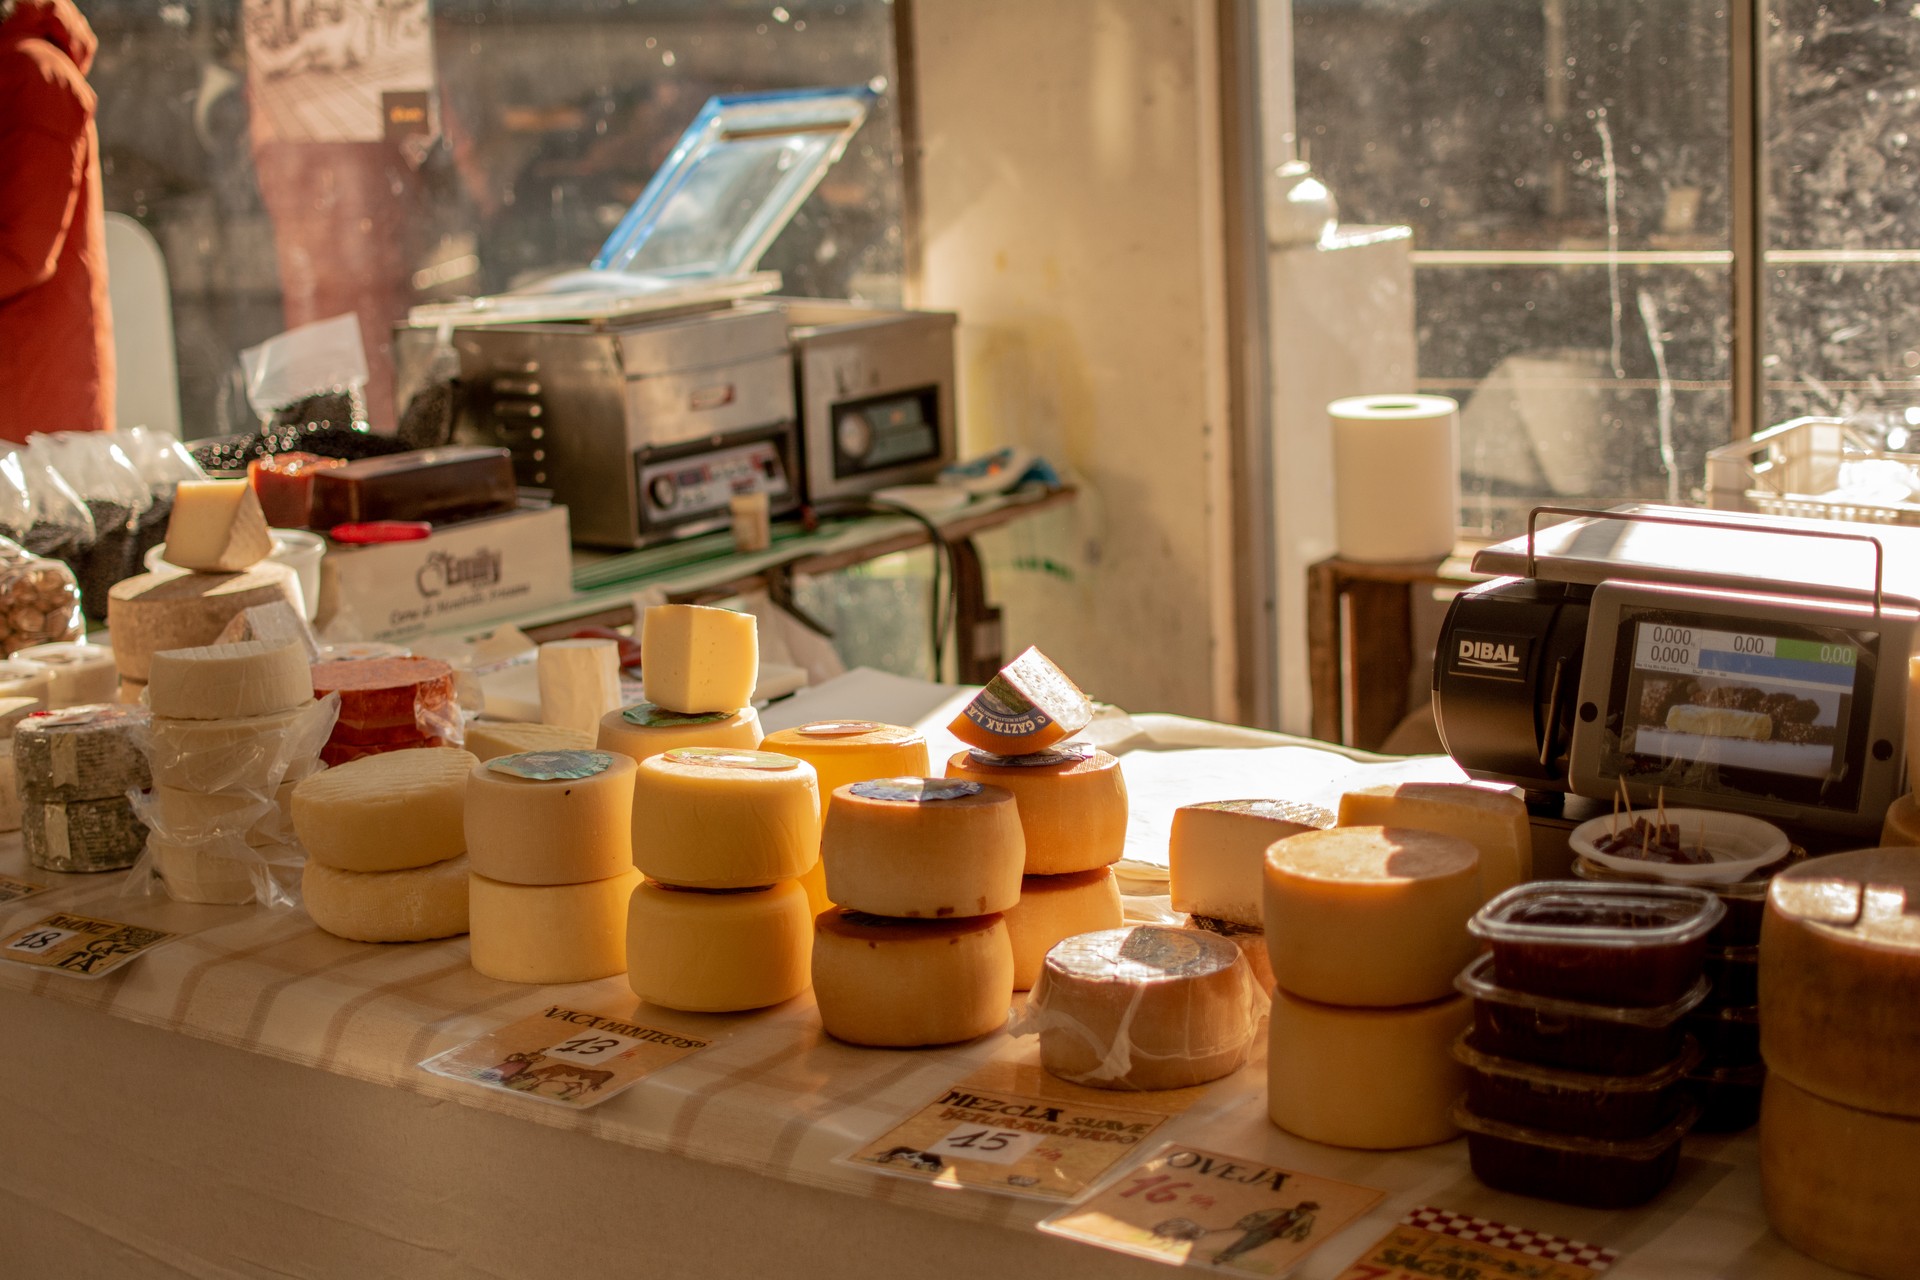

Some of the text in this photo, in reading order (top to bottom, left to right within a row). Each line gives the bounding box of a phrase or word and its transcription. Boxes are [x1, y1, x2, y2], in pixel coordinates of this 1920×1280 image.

[1653, 626, 1692, 646] 0,000
[1733, 635, 1765, 654] 0,00
[1459, 640, 1520, 663] DIBAL
[1650, 645, 1689, 665] 0,000
[1820, 645, 1852, 664] 0,00
[985, 718, 1036, 734] GAZTAK
[14, 930, 62, 949] 18
[555, 1036, 620, 1054] 13
[938, 1091, 1065, 1122] MEZCLA
[947, 1130, 1021, 1151] 15
[1166, 1151, 1292, 1192] OVEJA
[1119, 1174, 1194, 1204] 16
